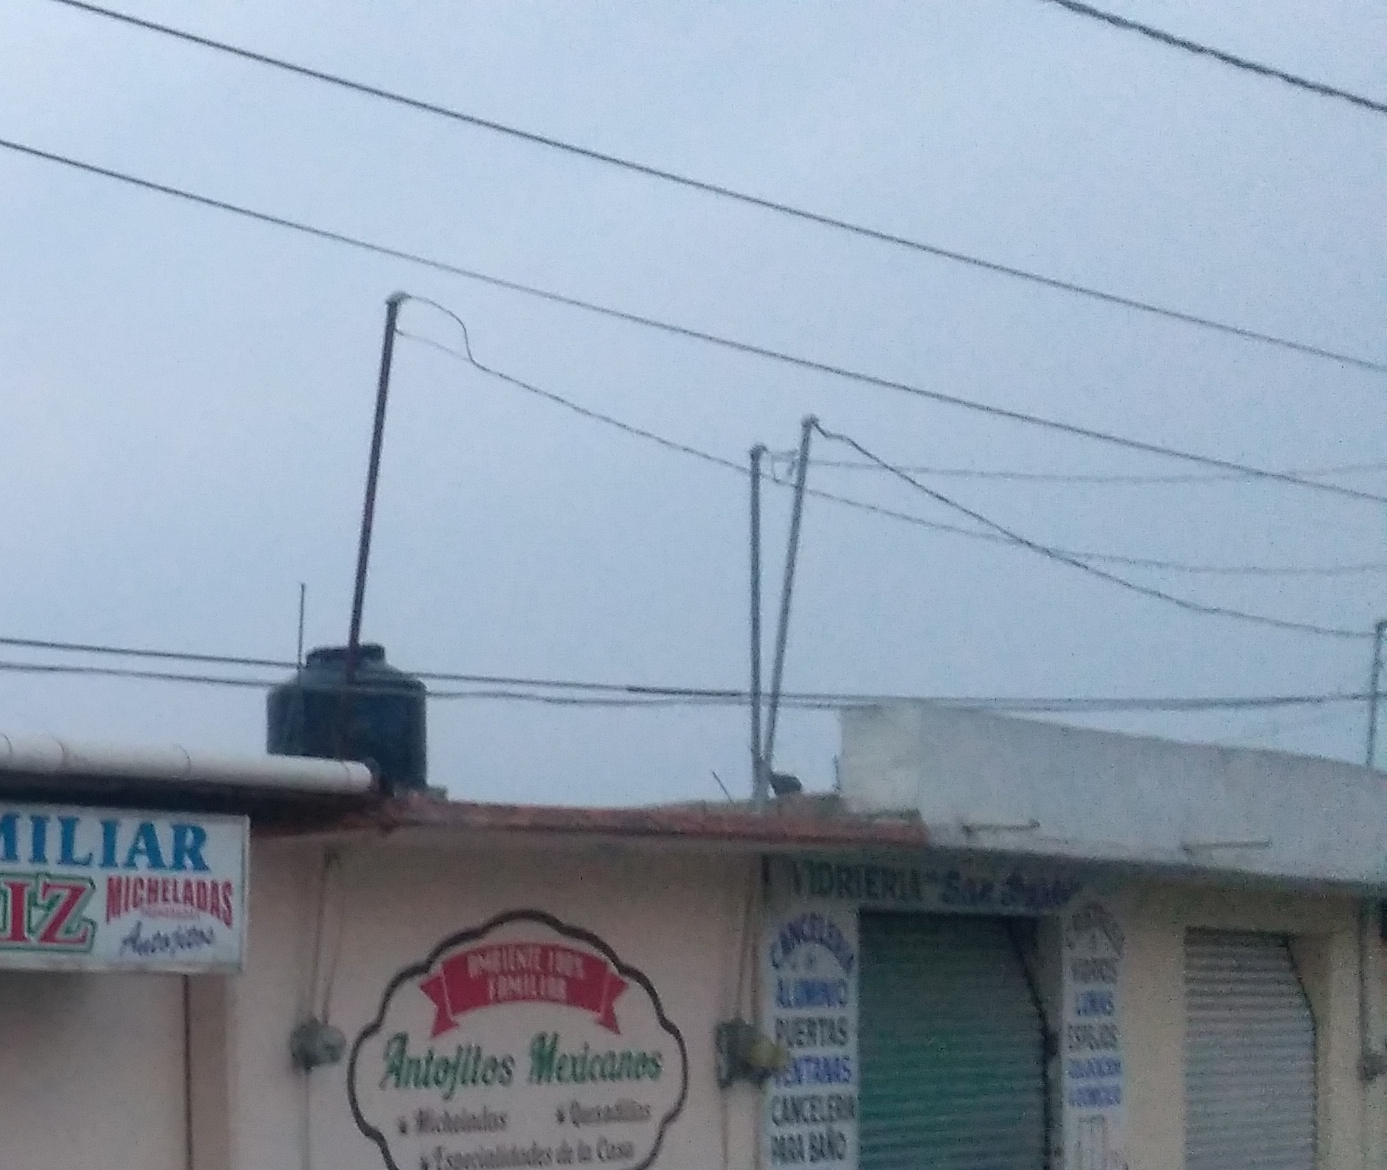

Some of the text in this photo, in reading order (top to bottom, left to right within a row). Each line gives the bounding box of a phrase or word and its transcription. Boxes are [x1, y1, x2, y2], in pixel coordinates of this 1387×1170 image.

[106, 876, 233, 928] MICHELADAS
[775, 1015, 848, 1048] PUERTAS
[379, 1031, 664, 1101] Antojitos Mexicanos
